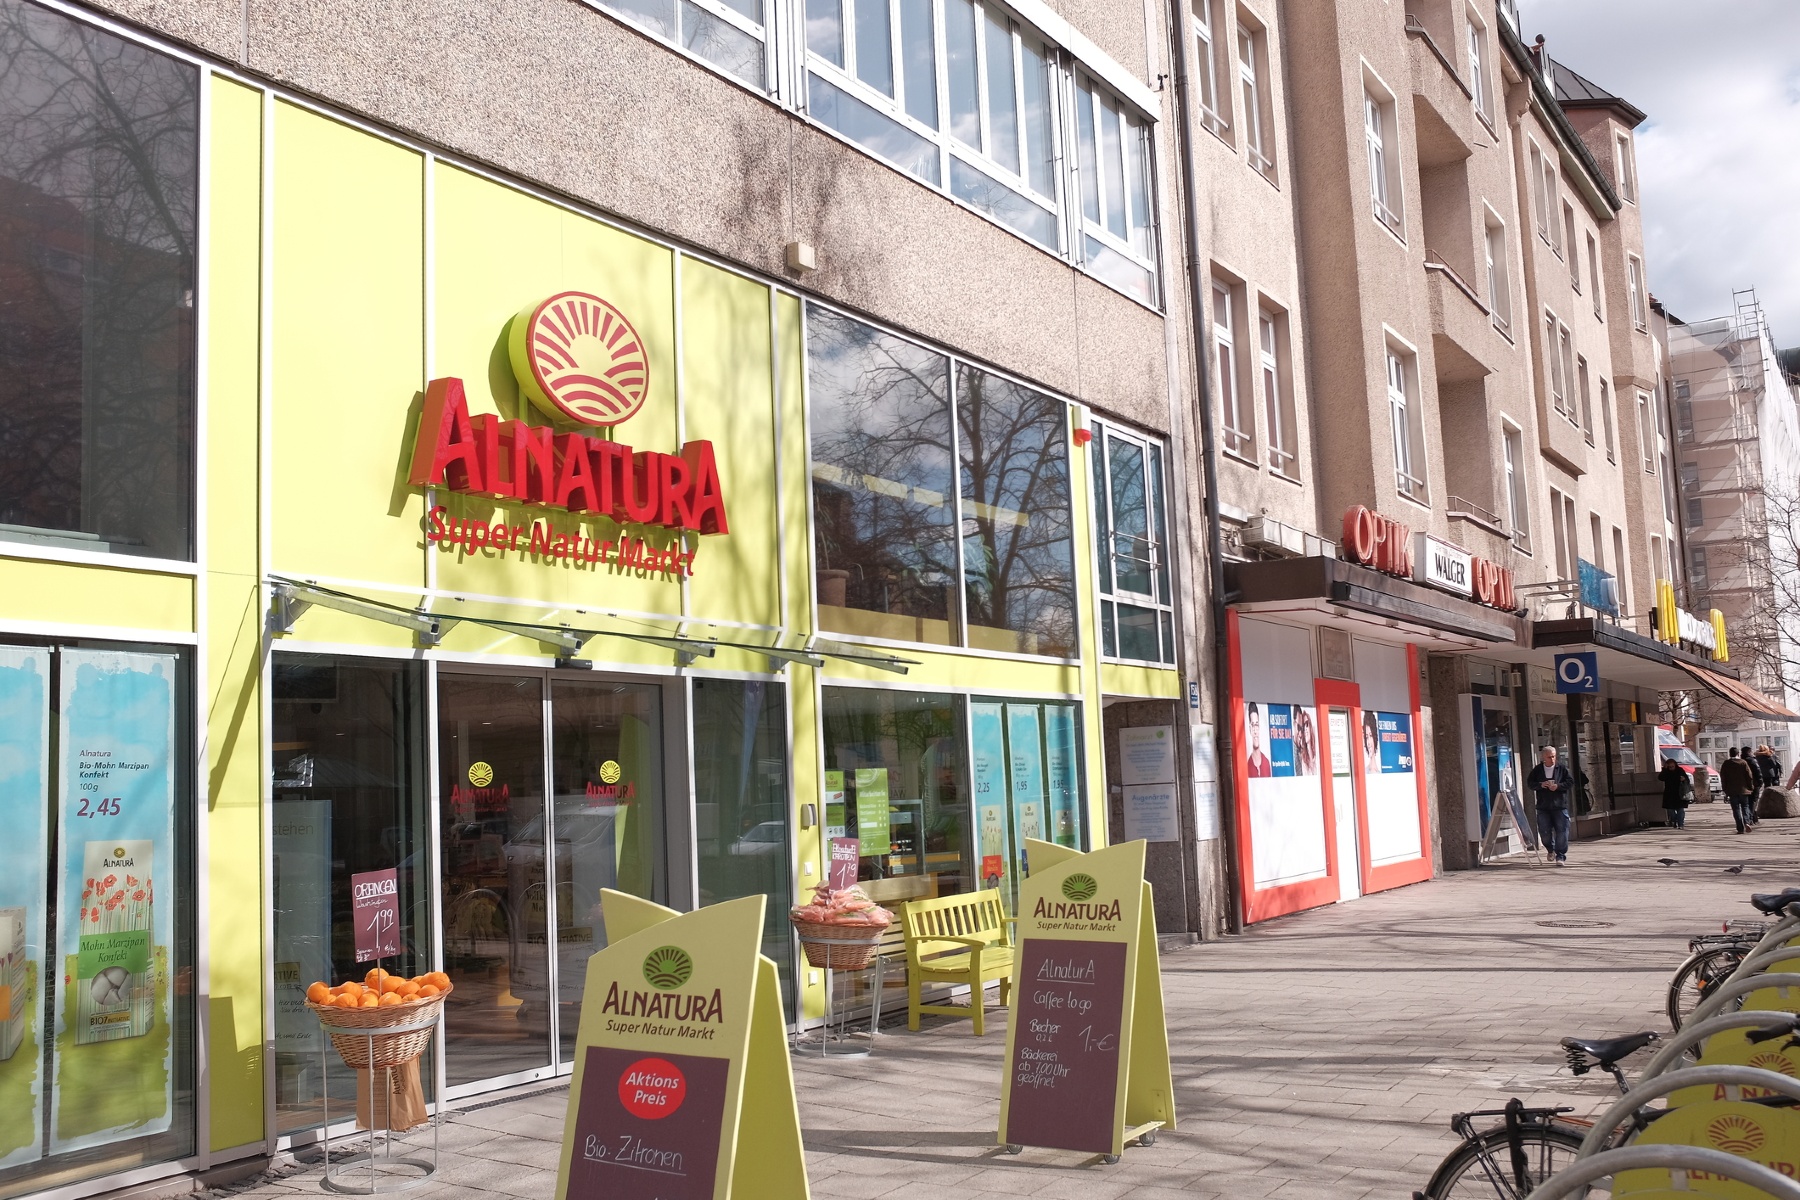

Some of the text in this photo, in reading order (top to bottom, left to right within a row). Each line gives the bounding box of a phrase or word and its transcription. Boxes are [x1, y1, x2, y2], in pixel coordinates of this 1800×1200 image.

[408, 377, 729, 536] ALNATURA
[427, 506, 696, 577] Super Natur Markt
[1343, 505, 1413, 578] OPTIK
[1434, 552, 1466, 587] WALGER
[1559, 657, 1594, 688] O2
[79, 771, 109, 779] Konfekt
[118, 762, 149, 771] Marzipan
[451, 784, 509, 804] ALNATURA
[585, 781, 636, 799] ALNATURA
[977, 782, 990, 793] 2,25
[1016, 781, 1028, 791] 1,95
[1132, 794, 1170, 803] Augenärzte
[77, 798, 121, 819] 2,45
[103, 858, 135, 868] ALNATURA
[354, 880, 397, 898] ORANGEN
[1033, 896, 1122, 921] ALNATURA
[1036, 921, 1116, 932] Super Natur Markt
[80, 937, 145, 952] Mohn Marzipan
[97, 952, 128, 965] Konfekt
[602, 981, 723, 1024] ALNATURA
[1078, 999, 1092, 1015] go
[605, 1019, 715, 1040] Super Natur Markt
[1029, 1018, 1061, 1034] Becher
[1021, 1046, 1058, 1061] Bäckerei
[1018, 1061, 1031, 1072] ab
[1053, 1063, 1071, 1078] Uhr
[626, 1072, 680, 1090] Aktions
[1017, 1073, 1056, 1089] geöffnet
[633, 1090, 667, 1106] Preis
[615, 1135, 683, 1172] Zitronen
